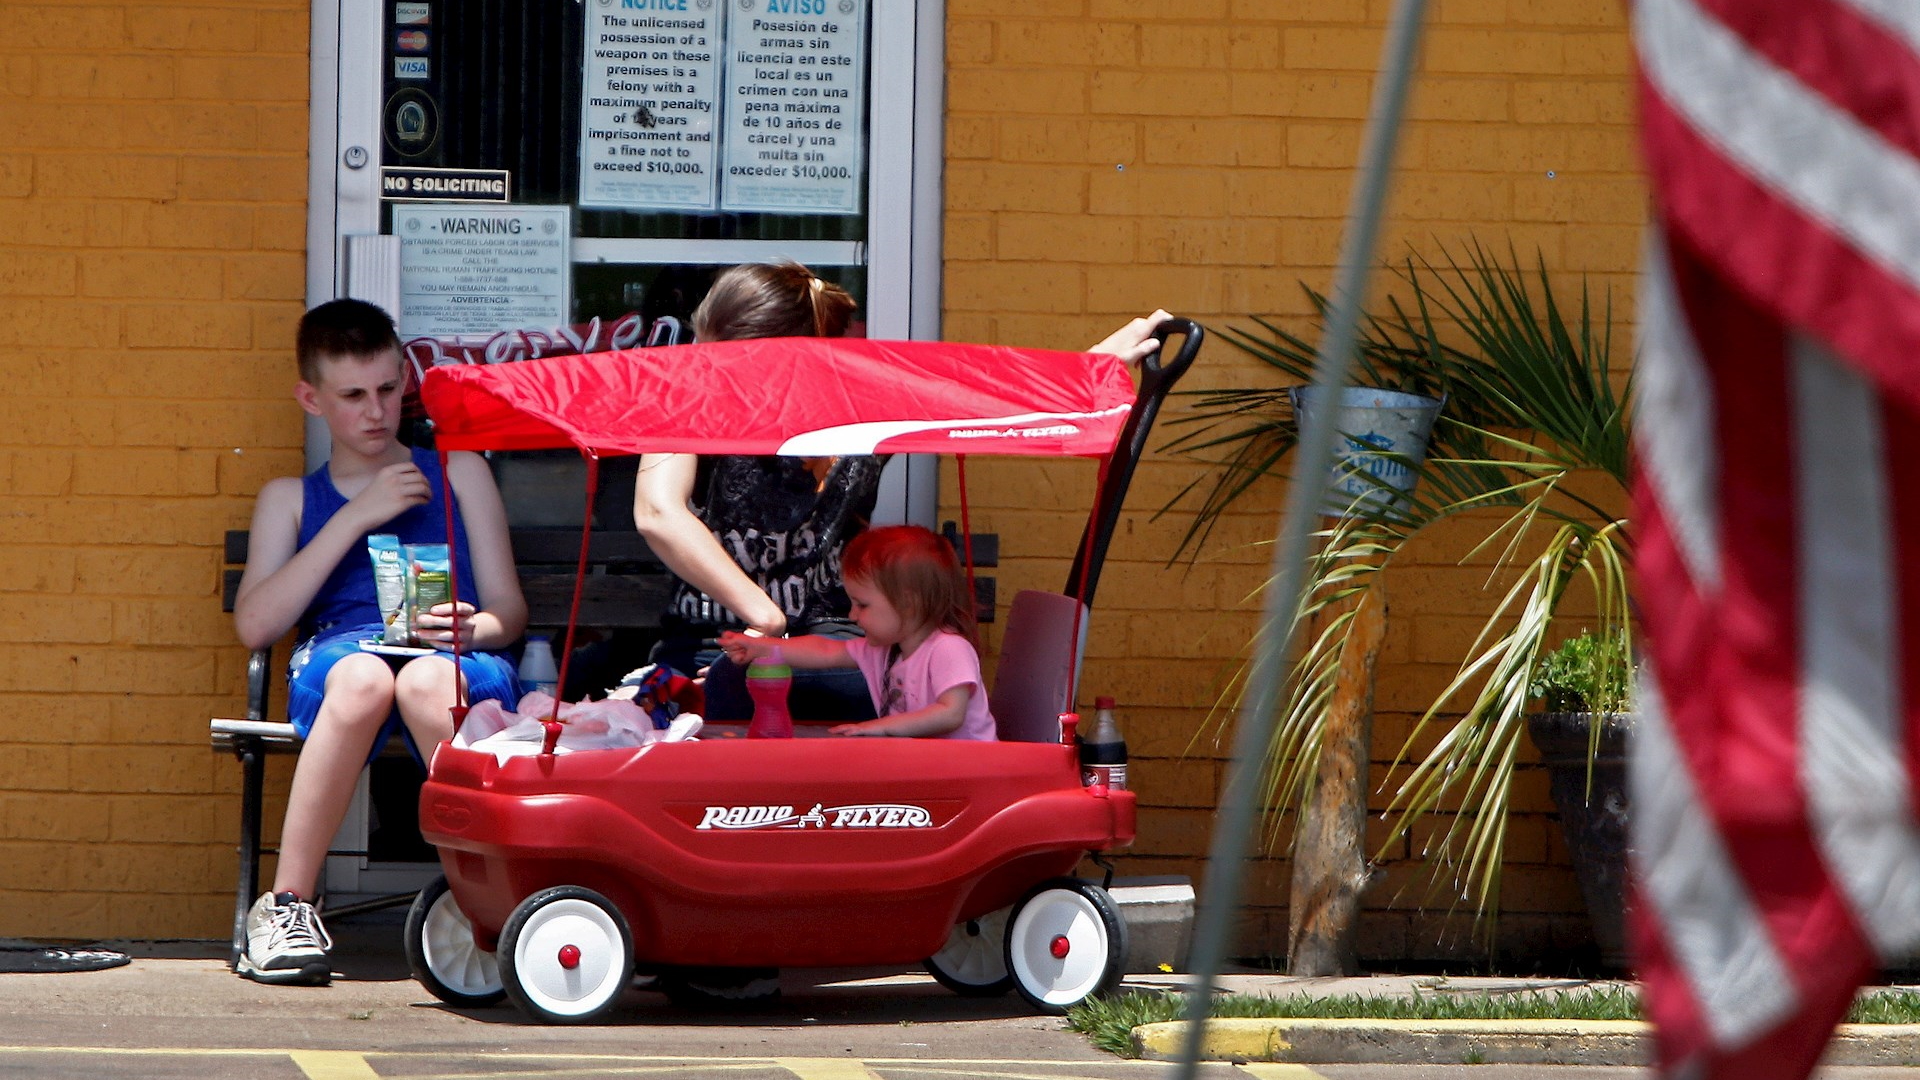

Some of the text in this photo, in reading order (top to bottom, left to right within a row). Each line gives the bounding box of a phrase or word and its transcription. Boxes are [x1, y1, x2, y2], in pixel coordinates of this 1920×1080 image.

[622, 0, 687, 10] NOTICE
[767, 0, 825, 14] AVISO
[602, 15, 705, 28] The unlicensed
[753, 19, 838, 32] Posesión de
[600, 33, 706, 45] possession of a
[760, 38, 829, 48] armas sin
[594, 49, 710, 61] weapon on these
[738, 51, 851, 65] licencia en este
[400, 62, 426, 72] VISA
[606, 65, 696, 77] premises is a
[755, 68, 832, 80] local es un
[608, 80, 694, 94] felony with a
[738, 84, 848, 97] crimen con una
[590, 97, 711, 112] maximum penalty
[745, 101, 840, 113] pena máxima
[613, 113, 626, 123] of
[743, 116, 841, 129] de 10 años de
[589, 128, 710, 141] imprisonment and
[748, 132, 835, 147] cárcel y una
[620, 145, 645, 155] fine
[650, 147, 671, 156] not
[677, 148, 689, 157] to
[759, 149, 824, 161] multa sin
[593, 161, 703, 174] exceed $10,000.
[730, 165, 850, 179] exceder $10,000.
[385, 177, 504, 192] NO SOLICITING
[441, 218, 520, 234] WARNING
[695, 806, 931, 829] RADIO FLYER
